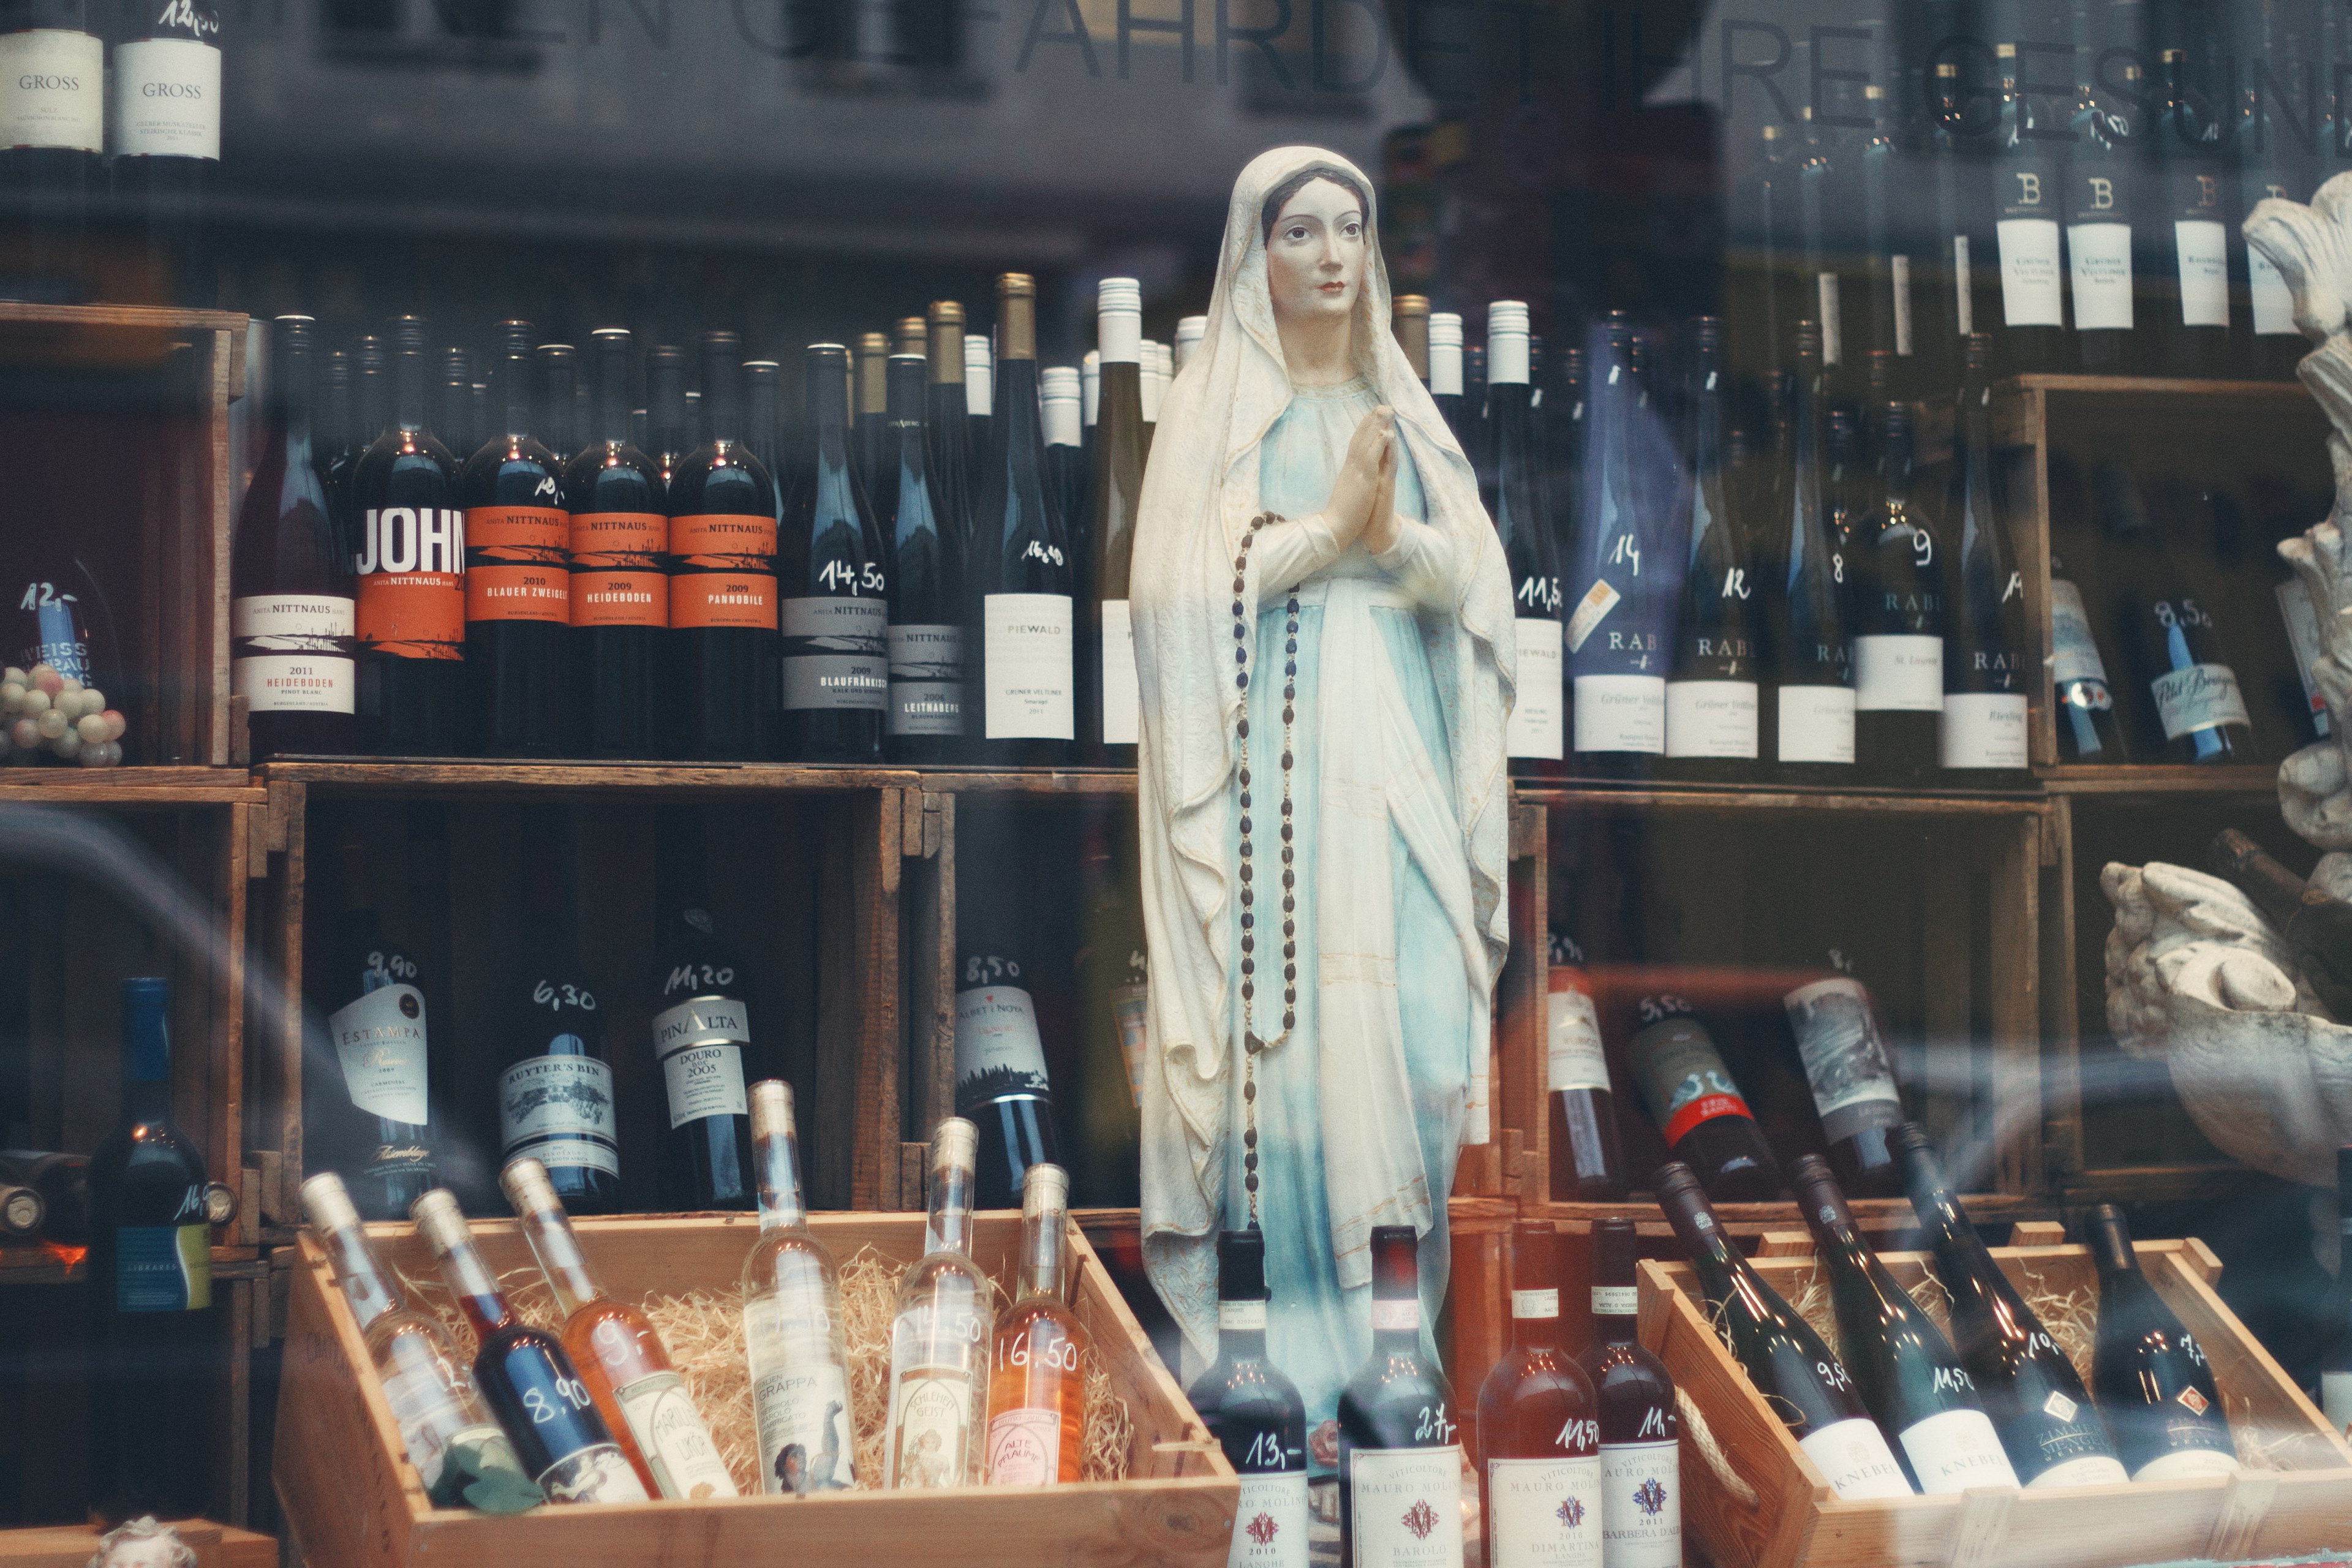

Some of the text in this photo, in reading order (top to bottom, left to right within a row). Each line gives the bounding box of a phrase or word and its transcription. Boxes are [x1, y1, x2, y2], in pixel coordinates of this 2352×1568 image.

[19, 75, 80, 91] GROSS
[143, 83, 202, 99] GROSS
[506, 516, 559, 526] NITTNAUS
[590, 522, 647, 532] NITTNAUS
[709, 524, 763, 535] NITTNAUS
[390, 576, 441, 587] NITTNAUS
[522, 577, 546, 586] 2010
[818, 558, 886, 596] 14,50
[608, 582, 633, 591] 2009
[725, 584, 749, 593] 2009
[487, 587, 527, 598] BLAUER
[586, 592, 652, 604] HEIDEBODEN
[707, 594, 764, 606] PANNOBILE
[272, 604, 331, 614] NITTNAUS
[834, 606, 882, 617] NITTNAUS
[1008, 625, 1061, 635] PIEWALD
[907, 633, 957, 643] NITTNAUS
[1518, 649, 1556, 659] IEWALD
[290, 666, 314, 676] 2011
[851, 666, 872, 675] 2009
[266, 677, 334, 688] HEIDEBODEN
[903, 701, 959, 714] LEITHABERG
[533, 980, 596, 1011] 6,30
[342, 1026, 421, 1046] ESTAMPA
[680, 1048, 722, 1066] DOURO
[508, 1063, 600, 1084] RUYTER'S BIN
[687, 1063, 717, 1079] 2005
[758, 1376, 818, 1401] GRAPPA
[910, 1391, 956, 1411] SCHLEHEN
[916, 1406, 947, 1418] GEIST
[1005, 1439, 1033, 1452] ALTE
[1246, 1431, 1302, 1469] 13,-
[997, 1449, 1041, 1468] PFLAUME
[1621, 1453, 1673, 1468] VITICOLTORE
[1940, 1453, 2006, 1477] KNEBEL
[1389, 1464, 1447, 1480] VITICOLTORE
[1540, 1466, 1594, 1482] VITICOLTORE
[1604, 1468, 1644, 1478] AURO
[1834, 1463, 1898, 1491] KNEBEL
[1361, 1483, 1414, 1494] MAURO
[1510, 1482, 1564, 1492] MAURO
[1638, 1517, 1664, 1526] 2011
[1559, 1532, 1583, 1540] 2010
[1602, 1529, 1657, 1540] BARBERA
[1248, 1547, 1276, 1556] 2010
[1393, 1544, 1447, 1558] BAROLO
